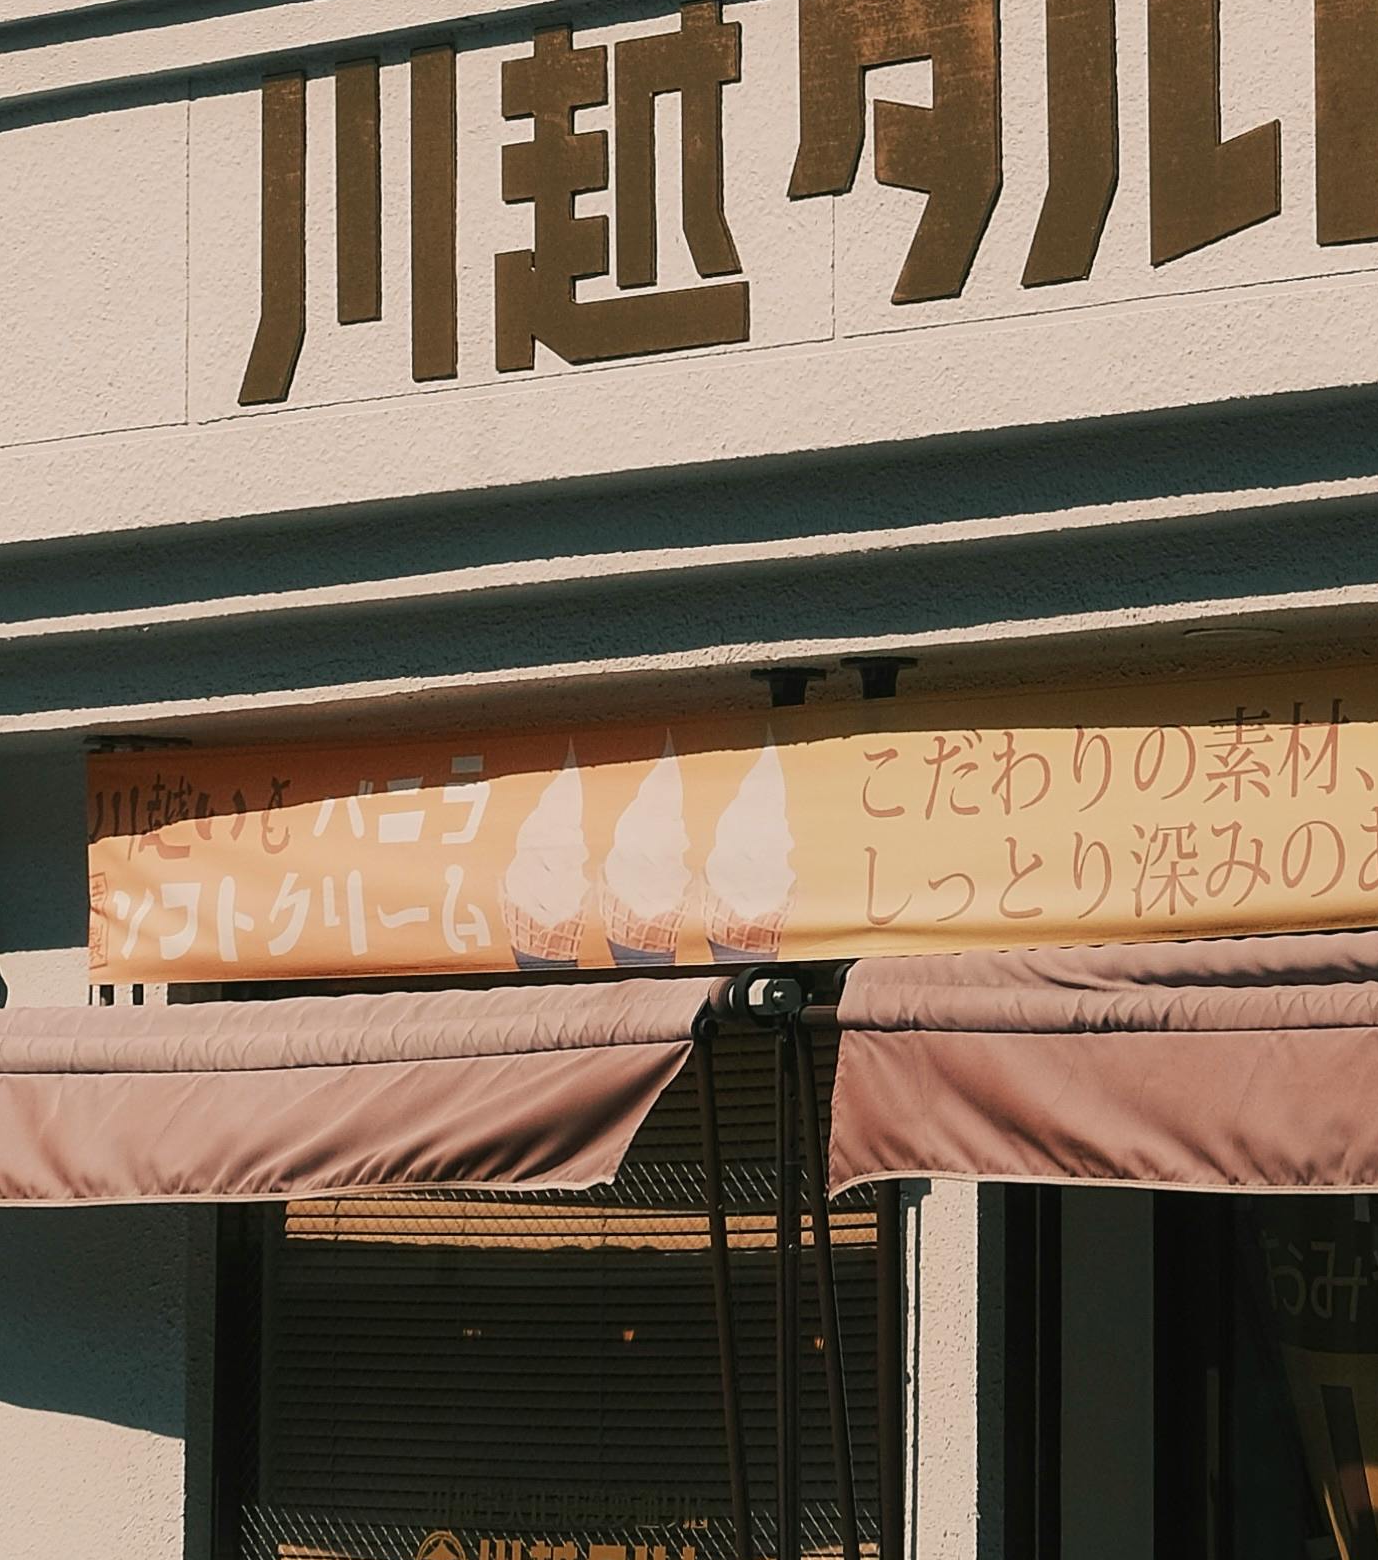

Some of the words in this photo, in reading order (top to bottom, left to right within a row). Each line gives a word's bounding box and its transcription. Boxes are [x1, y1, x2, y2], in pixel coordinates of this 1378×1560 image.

[313, 755, 494, 844] バニラ
[860, 697, 1376, 820] こだわりの素材、
[90, 773, 291, 860] 川越いも
[113, 864, 492, 962] ソフトクリーム
